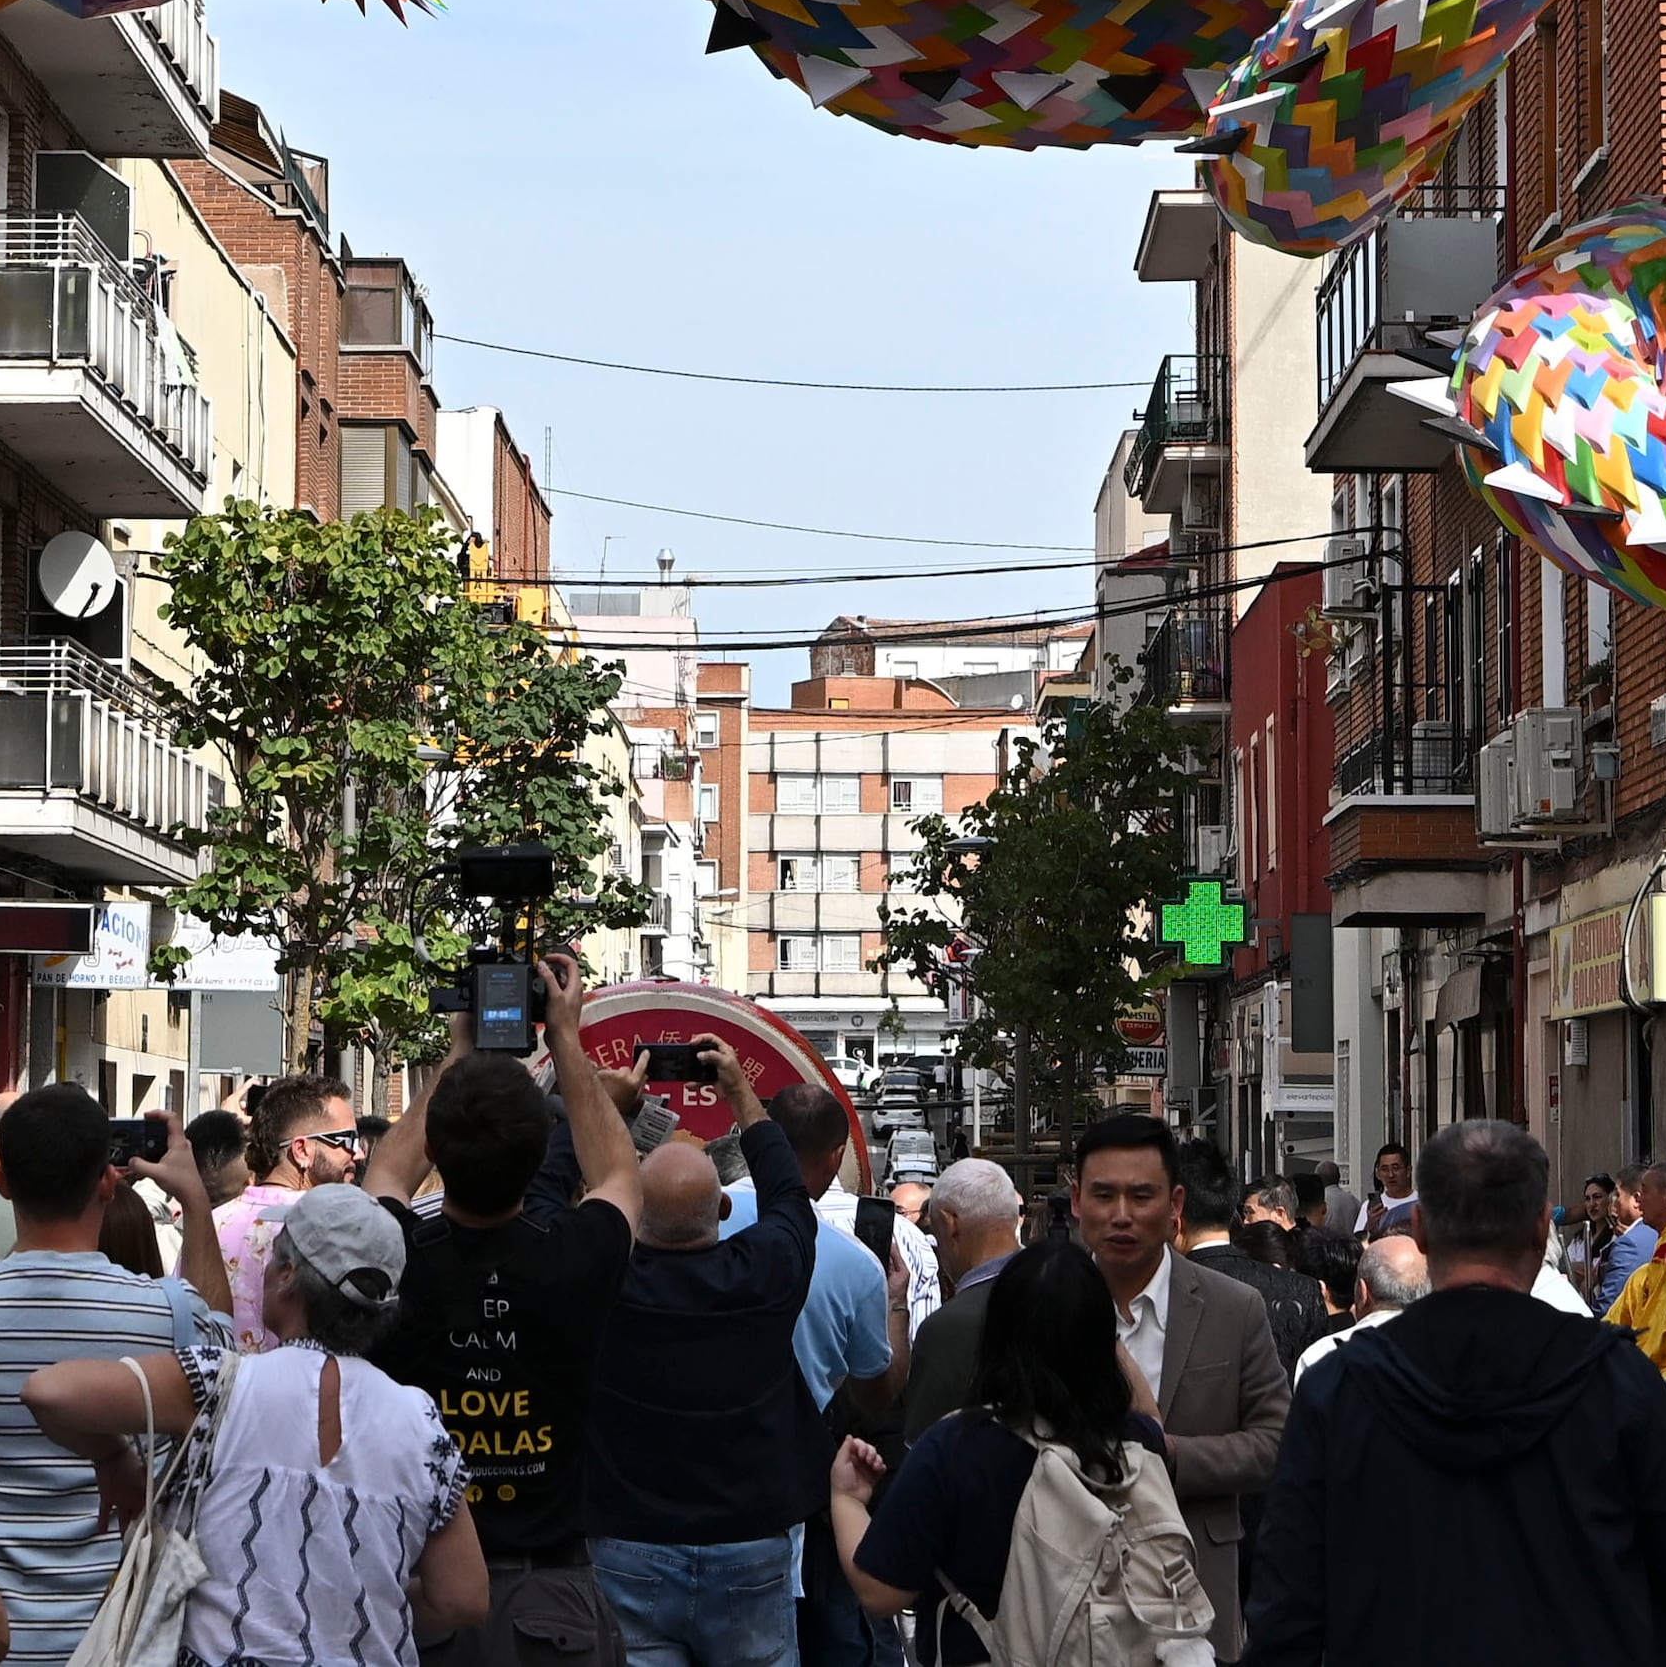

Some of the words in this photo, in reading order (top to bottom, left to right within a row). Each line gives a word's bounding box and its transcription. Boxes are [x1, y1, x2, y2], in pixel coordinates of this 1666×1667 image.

[37, 973, 53, 983] PAN
[56, 973, 66, 983] DE
[69, 973, 96, 984] HORNO
[100, 974, 105, 983] Y
[109, 974, 142, 984] BEBIDAS
[483, 1299, 510, 1319] EP
[466, 1367, 502, 1382] AND
[440, 1389, 530, 1417] LOVE
[447, 1426, 552, 1456] OALAS
